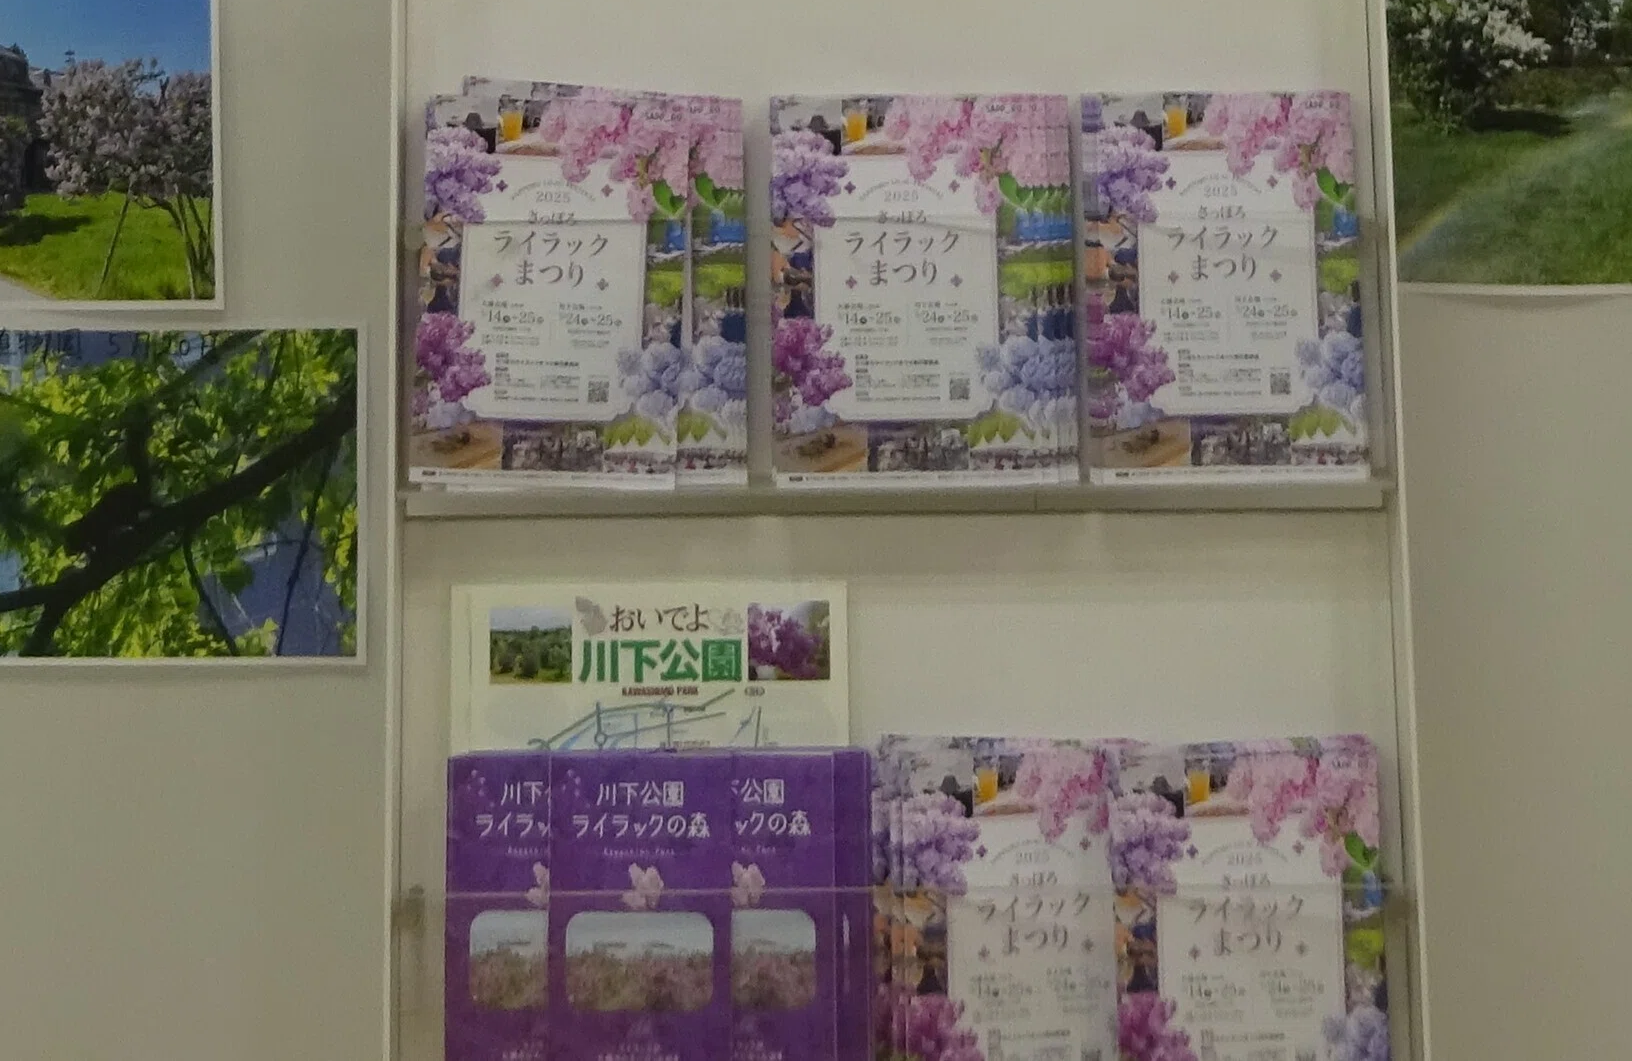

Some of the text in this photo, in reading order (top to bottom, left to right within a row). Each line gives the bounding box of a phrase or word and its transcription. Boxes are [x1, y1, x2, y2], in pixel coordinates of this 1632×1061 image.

[535, 191, 571, 203] 2025
[528, 209, 575, 225] さっぽろ
[494, 230, 608, 258] ライラック
[845, 231, 959, 255] ライラック
[1168, 225, 1278, 250] ライラック
[516, 260, 584, 287] まつり
[869, 259, 937, 285] まつり
[1191, 254, 1256, 281] まつり
[610, 603, 709, 632] おいでよ
[579, 639, 742, 682] 川下公園
[597, 781, 684, 807] 川下公園
[573, 812, 710, 838] ライラックの森
